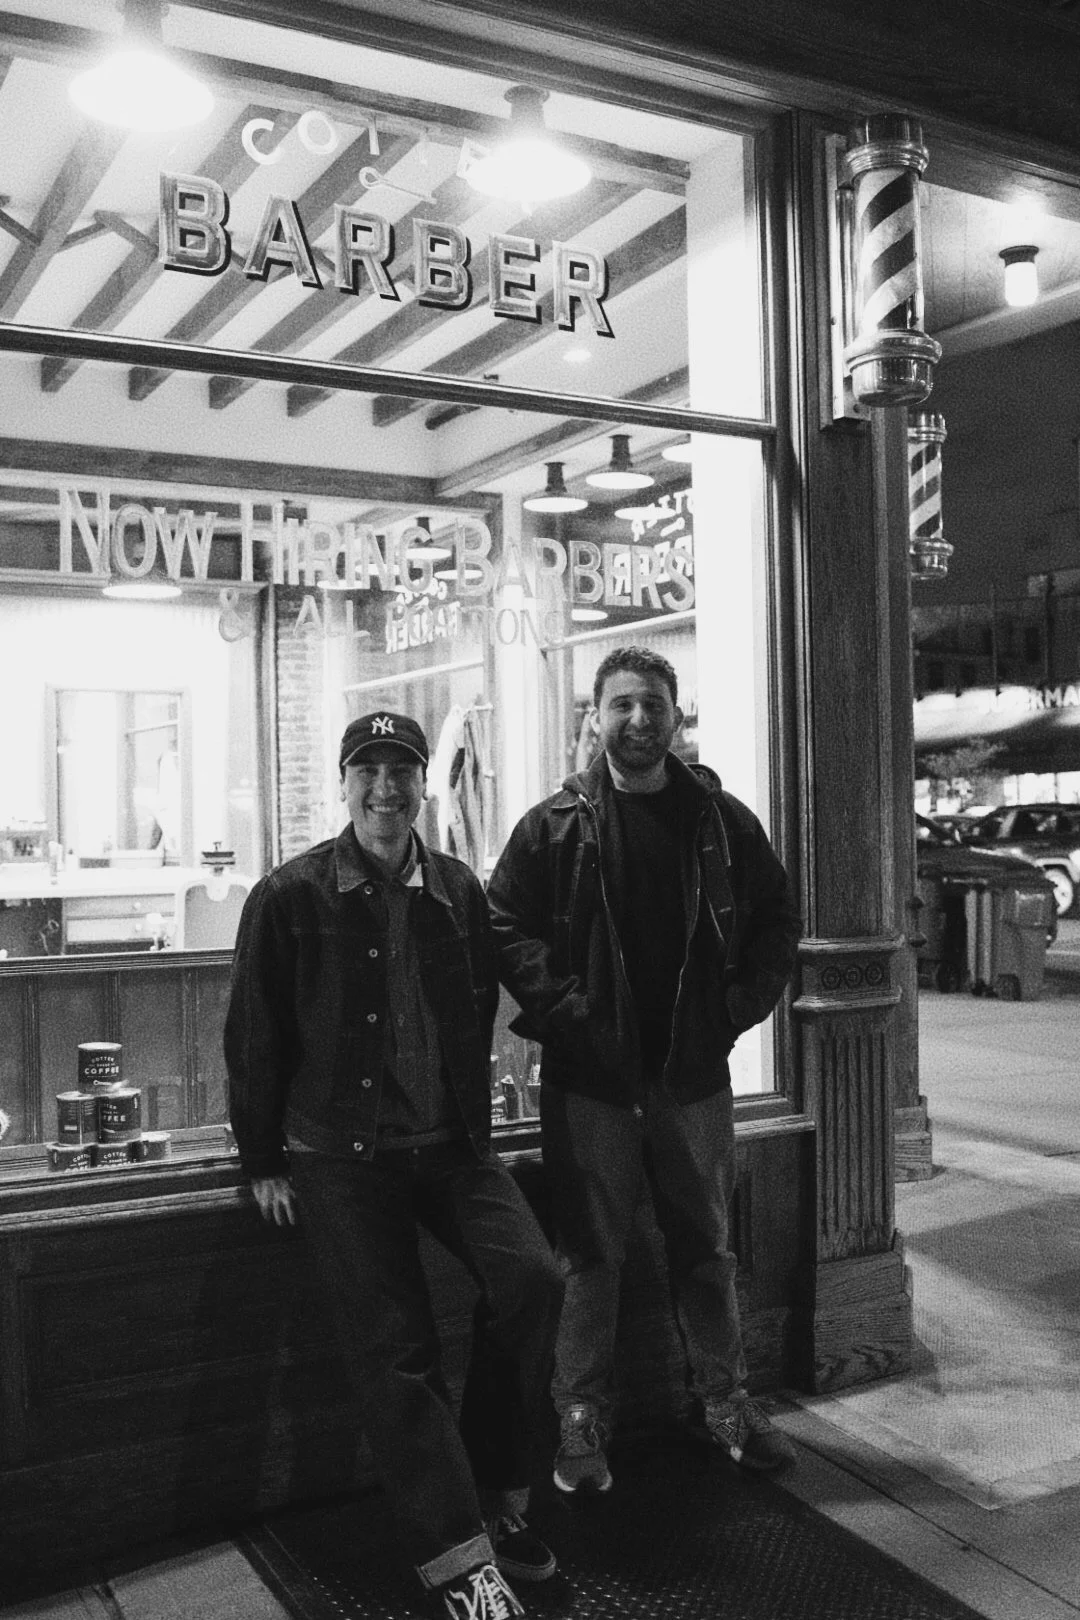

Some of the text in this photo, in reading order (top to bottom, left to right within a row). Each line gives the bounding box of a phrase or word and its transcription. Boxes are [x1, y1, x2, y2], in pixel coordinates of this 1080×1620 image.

[157, 171, 615, 340] BARBER
[58, 485, 696, 611] NOW HIRING BARBERS
[371, 715, 395, 735] NY
